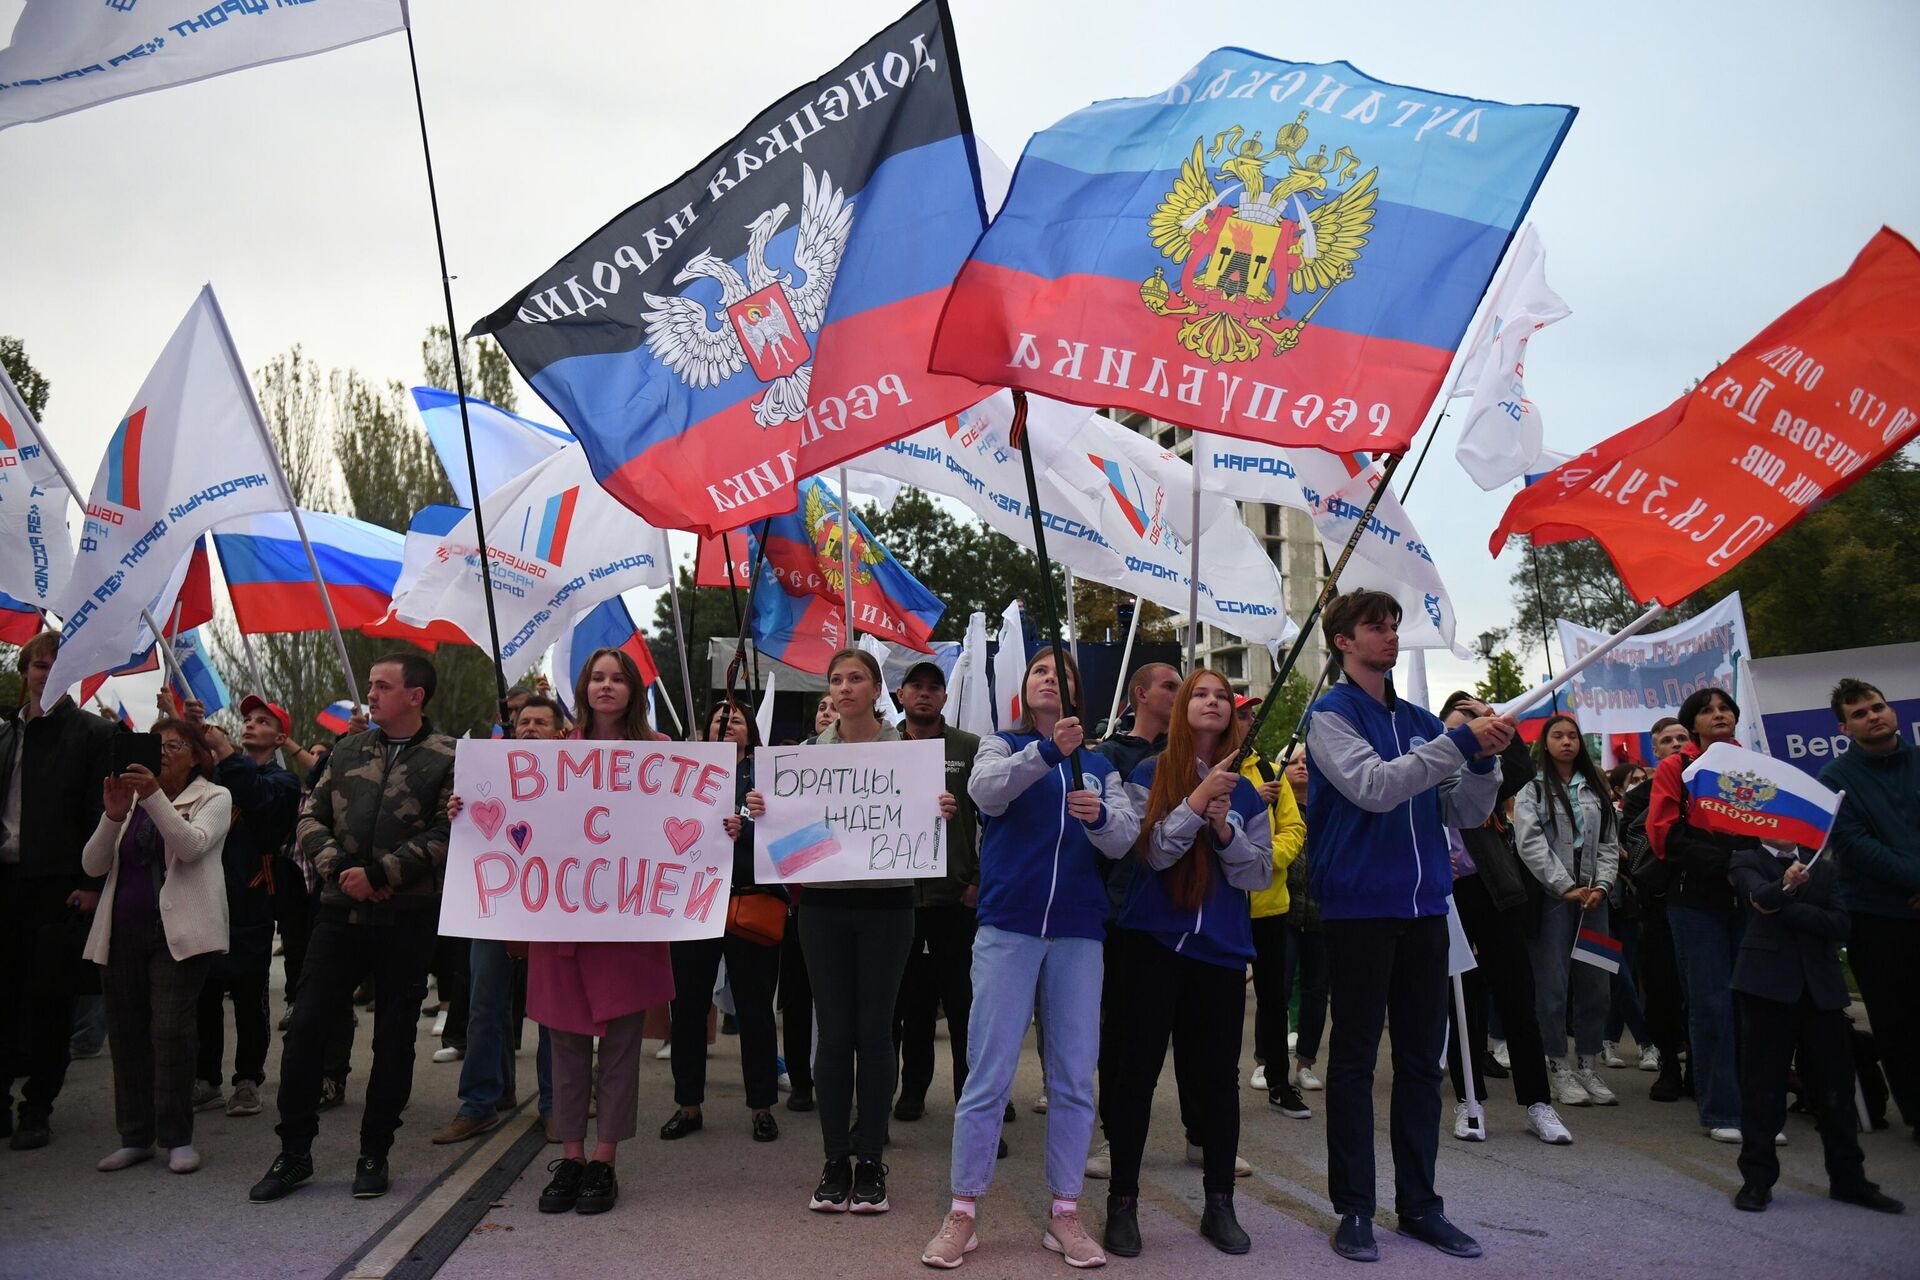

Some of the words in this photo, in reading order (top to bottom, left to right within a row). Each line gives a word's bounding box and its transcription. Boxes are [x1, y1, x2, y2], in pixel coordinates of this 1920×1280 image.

[1024, 505, 1110, 549] РОССИЮ
[1125, 556, 1179, 584] ФРОНТ
[1652, 623, 1733, 667] Путину
[473, 851, 723, 924] РОССИЕЙ
